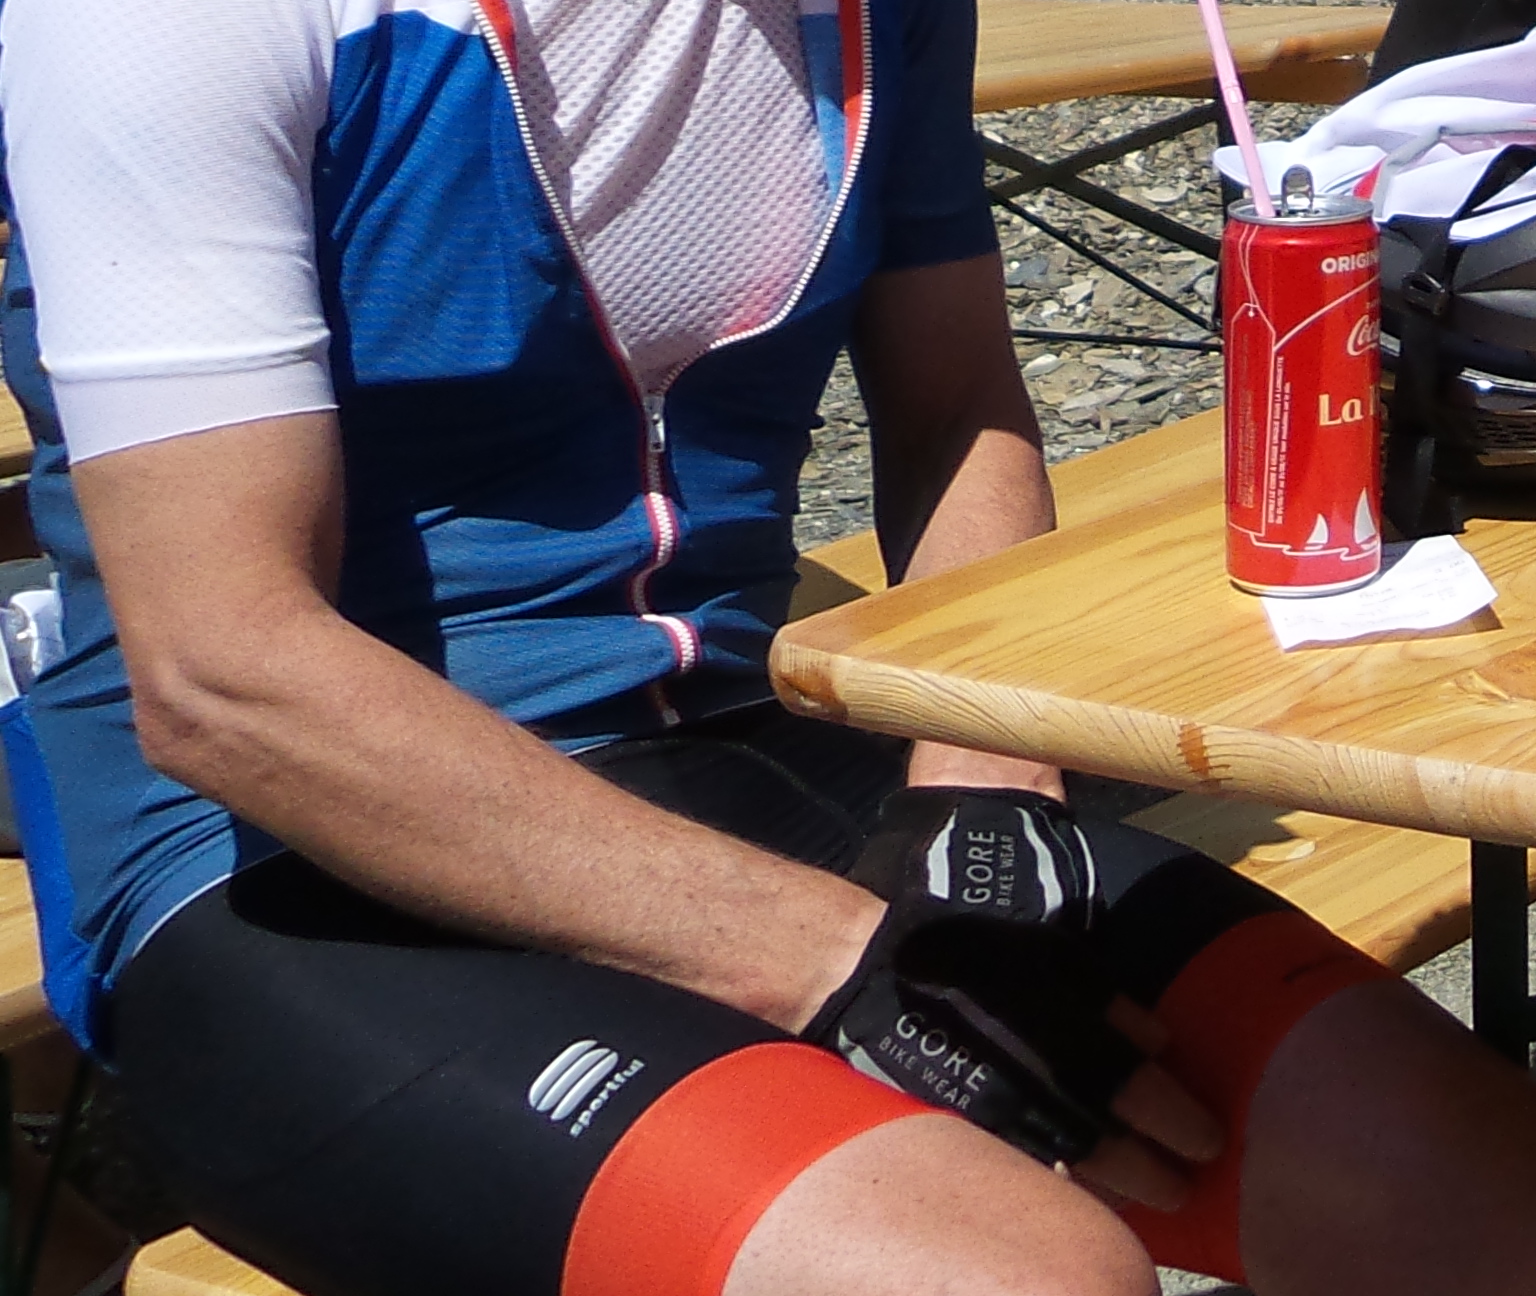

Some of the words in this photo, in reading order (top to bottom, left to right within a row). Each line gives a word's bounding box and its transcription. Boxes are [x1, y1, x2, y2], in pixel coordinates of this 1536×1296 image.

[1318, 393, 1363, 426] La
[963, 831, 995, 904] GORE
[1000, 835, 1015, 868] WEAR
[996, 874, 1015, 906] BIKE
[879, 1036, 917, 1071] BIKE
[922, 1067, 971, 1110] WEAR
[896, 1011, 990, 1092] GORE
[569, 1058, 645, 1138] sportful
